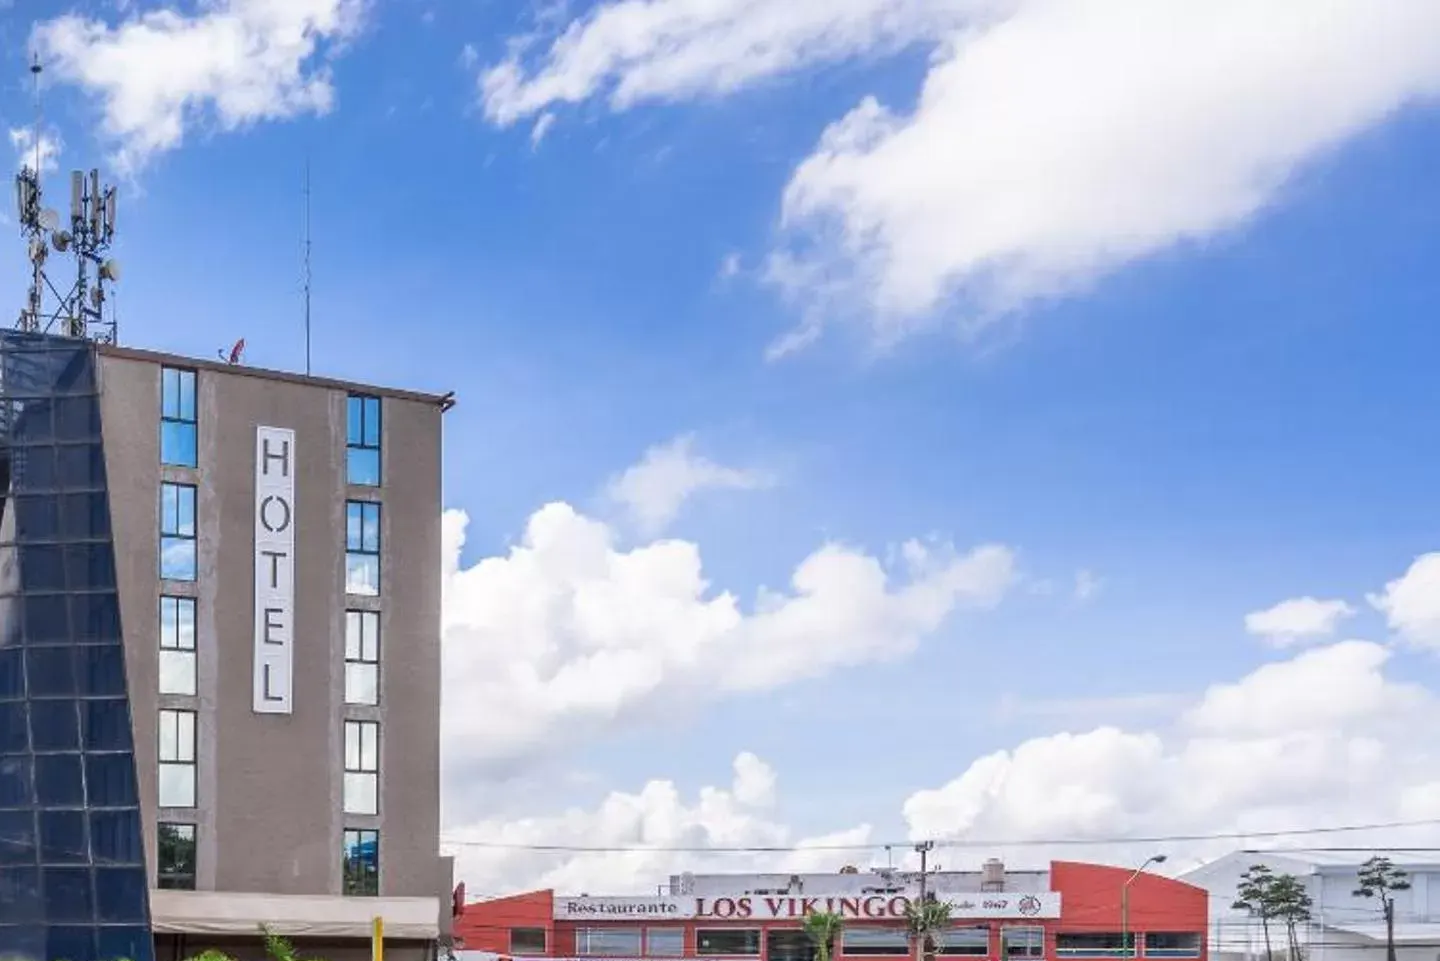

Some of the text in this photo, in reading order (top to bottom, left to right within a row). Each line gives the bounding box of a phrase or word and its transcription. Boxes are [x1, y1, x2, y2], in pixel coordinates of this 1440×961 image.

[260, 438, 291, 702] HOTEL
[567, 901, 678, 914] Restaurante
[695, 896, 912, 918] LOS VIKINGO
